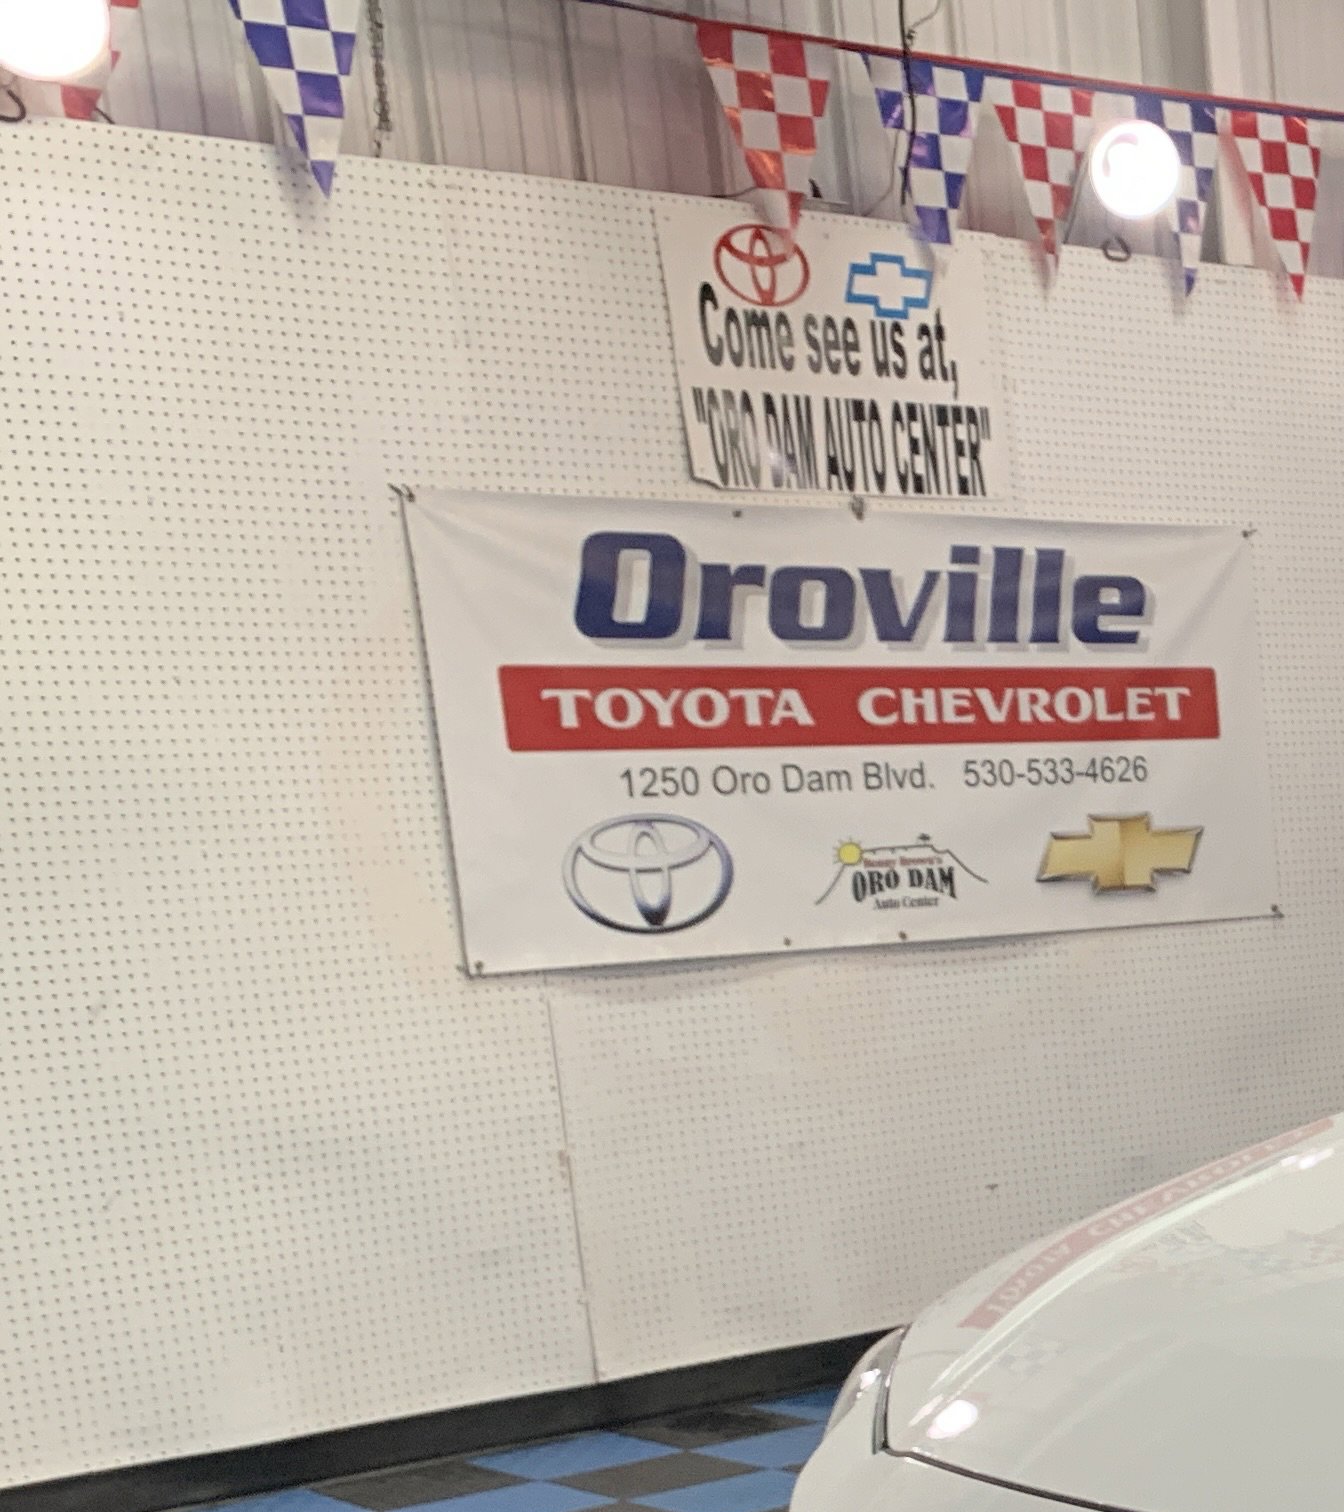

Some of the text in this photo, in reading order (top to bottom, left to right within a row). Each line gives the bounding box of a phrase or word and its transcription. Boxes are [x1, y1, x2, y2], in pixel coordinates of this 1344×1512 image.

[699, 282, 958, 400] Come see us at,
[762, 392, 819, 489] DAM
[824, 397, 886, 492] AUTO
[573, 531, 1151, 647] Oroville
[541, 686, 1191, 729] TOYOTA CHEVROLET
[620, 756, 1148, 798] 1250 Oro Dam Blvd. 530-533-4626
[852, 866, 957, 902] ORO DAM
[873, 896, 938, 910] Auto Center
